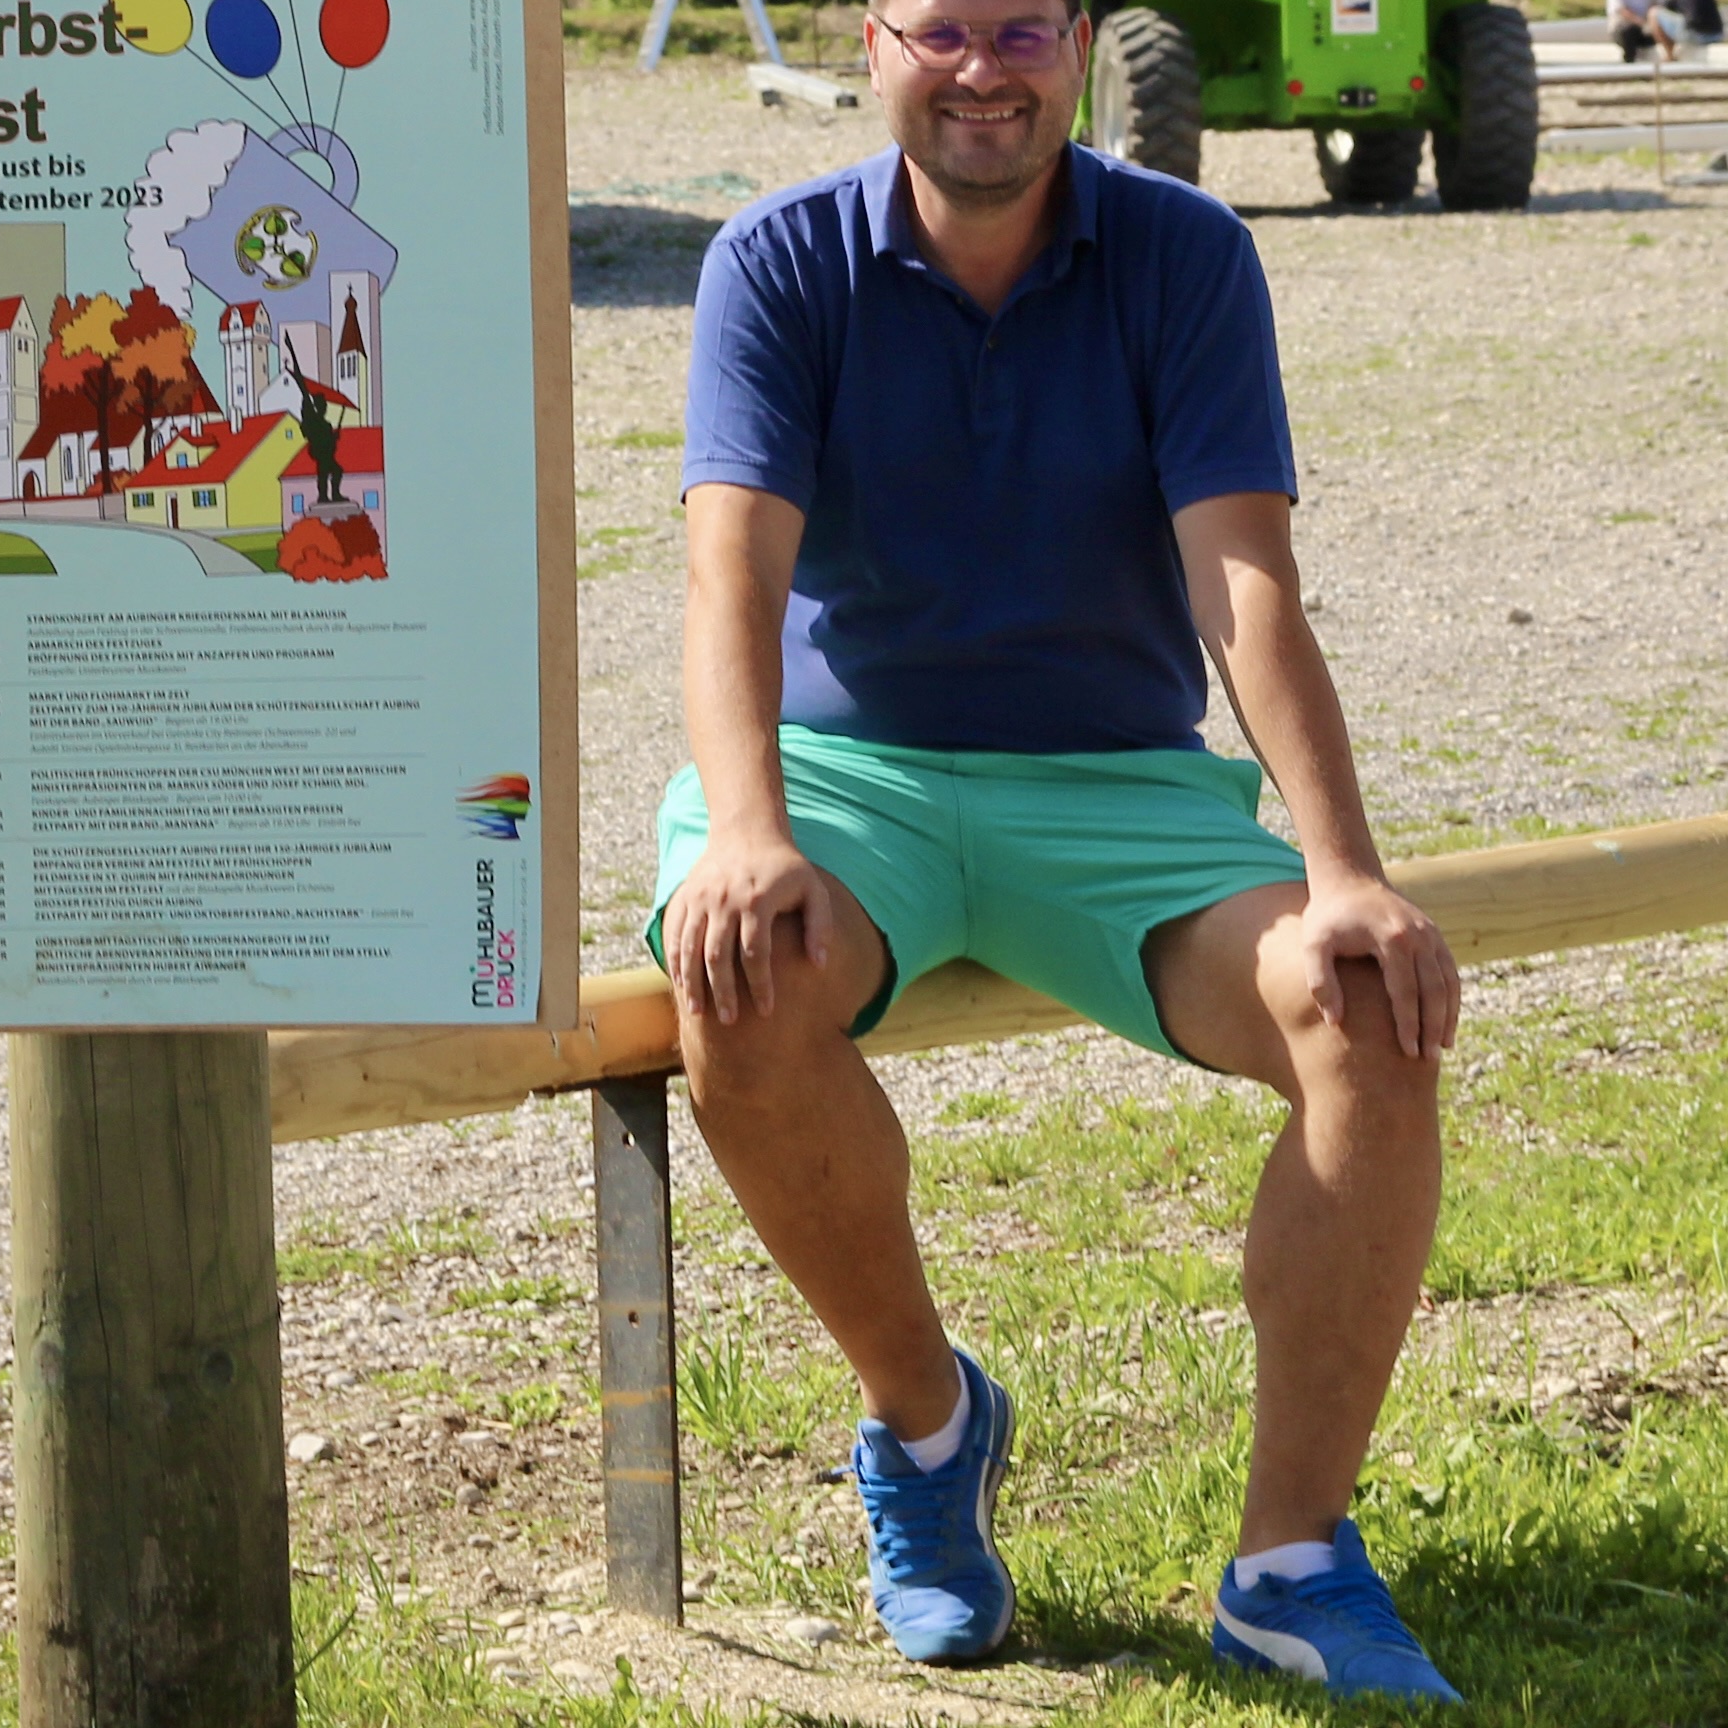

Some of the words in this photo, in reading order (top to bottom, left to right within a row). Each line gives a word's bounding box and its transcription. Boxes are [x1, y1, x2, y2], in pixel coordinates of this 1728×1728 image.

[48, 153, 87, 180] bis
[100, 184, 164, 211] 2023
[27, 613, 104, 624] STANDKONZERT
[109, 612, 123, 623] AM
[127, 612, 176, 623] AUBINGER
[179, 610, 266, 622] KRIEGERDENKMAL
[271, 610, 287, 621] MIT
[291, 609, 347, 621] BLASMUSIK
[85, 639, 104, 650] DES
[106, 638, 162, 650] FESTZUGES
[28, 651, 88, 664] ERÖFFNUNG
[91, 653, 110, 663] DES
[112, 652, 174, 663] FESTABENDS
[177, 651, 193, 662] MIT
[198, 651, 249, 662] ANZAPFEN
[252, 650, 274, 661] UND
[276, 649, 334, 660] PROGRAMM
[29, 692, 62, 703] MARKT
[66, 692, 88, 702] UND
[90, 691, 150, 702] FLOHMARKT
[153, 690, 166, 701] IM
[168, 690, 189, 700] ZELT
[30, 705, 82, 716] ZELTPARTY
[86, 704, 108, 715] ZUM
[183, 701, 232, 713] JUBILÄUM
[234, 702, 253, 713] DER
[256, 699, 379, 712] SCHÜTZENGESELLSCHAFT
[383, 700, 420, 710] AUBING
[30, 718, 46, 729] MIT
[50, 718, 69, 729] DER
[72, 718, 100, 728] BAND
[31, 769, 94, 780] POLITISCHER
[97, 766, 176, 779] FRÜHSCHOPPEN
[178, 767, 198, 778] DER
[200, 767, 220, 778] CSU
[222, 765, 272, 777] MÜNCHEN
[274, 766, 299, 777] WEST
[303, 766, 319, 776] MIT
[322, 765, 344, 776] DEM
[346, 765, 406, 776] BAYRISCHEN
[32, 780, 146, 793] MINISTERPRÄSIDENTEN
[168, 781, 208, 791] MARKUS
[212, 779, 244, 790] SÖDER
[246, 780, 268, 790] UND
[272, 780, 298, 790] JOSEF
[74, 808, 96, 818] UND
[99, 806, 210, 818] FAMILIENNACHMITTAG
[213, 806, 228, 816] MIT
[232, 803, 300, 816] ERMÄSSIGTEN
[303, 804, 343, 815] PREISEN
[33, 821, 85, 832] ZELTPARTY
[89, 821, 104, 832] MIT
[109, 821, 128, 831] DER
[131, 820, 158, 831] BAND
[33, 847, 48, 858] DIE
[52, 844, 176, 858] SCHÜTZENGESELLSCHAFT
[181, 845, 217, 856] AUBING
[220, 845, 250, 855] FEIERT
[254, 844, 271, 855] IHR
[344, 841, 392, 854] JUBILÄUM
[33, 860, 81, 871] EMPFANG
[84, 860, 102, 870] DER
[105, 860, 144, 870] VEREINE
[149, 859, 163, 869] AM
[166, 859, 210, 869] FESTZELT
[213, 858, 230, 868] MIT
[234, 856, 312, 868] FRÜHSCHOPPEN
[34, 873, 89, 884] FELDMESSE
[92, 873, 103, 883] IN
[121, 872, 156, 883] QUIRIN
[158, 872, 174, 882] MIT
[179, 870, 294, 882] FAHNENABORDNUNGEN
[34, 885, 102, 896] MITTAGESSEN
[104, 884, 116, 895] IM
[34, 898, 79, 909] GROSSER
[82, 898, 126, 908] FESTZUG
[128, 897, 162, 908] DURCH
[166, 897, 202, 907] AUBING
[35, 911, 87, 922] ZELTPARTY
[91, 911, 107, 921] MIT
[112, 911, 130, 921] DER
[170, 910, 191, 920] UND
[194, 909, 290, 920] OKTOBERFESTBAND
[470, 858, 495, 1008] MÜHLBAUER
[36, 935, 92, 948] GÜNSTIGER
[94, 936, 165, 947] MITTAGSTISCH
[168, 936, 190, 947] UND
[193, 935, 290, 946] SENIORENANGEBOTE
[294, 935, 306, 945] IM
[310, 934, 329, 945] ZELT
[36, 950, 91, 961] POLITISCHE
[97, 949, 212, 960] ABENDVERANSTALTUNG
[214, 949, 232, 959] DER
[235, 949, 268, 959] FREIEN
[270, 947, 310, 959] WÄHLER
[313, 948, 329, 959] MIT
[332, 948, 354, 958] DEM
[36, 961, 150, 973] MINISTERPRÄSIDENTEN
[153, 962, 190, 972] HUBERT
[195, 961, 246, 971] AIWANGER
[497, 928, 515, 1008] DRUCK
